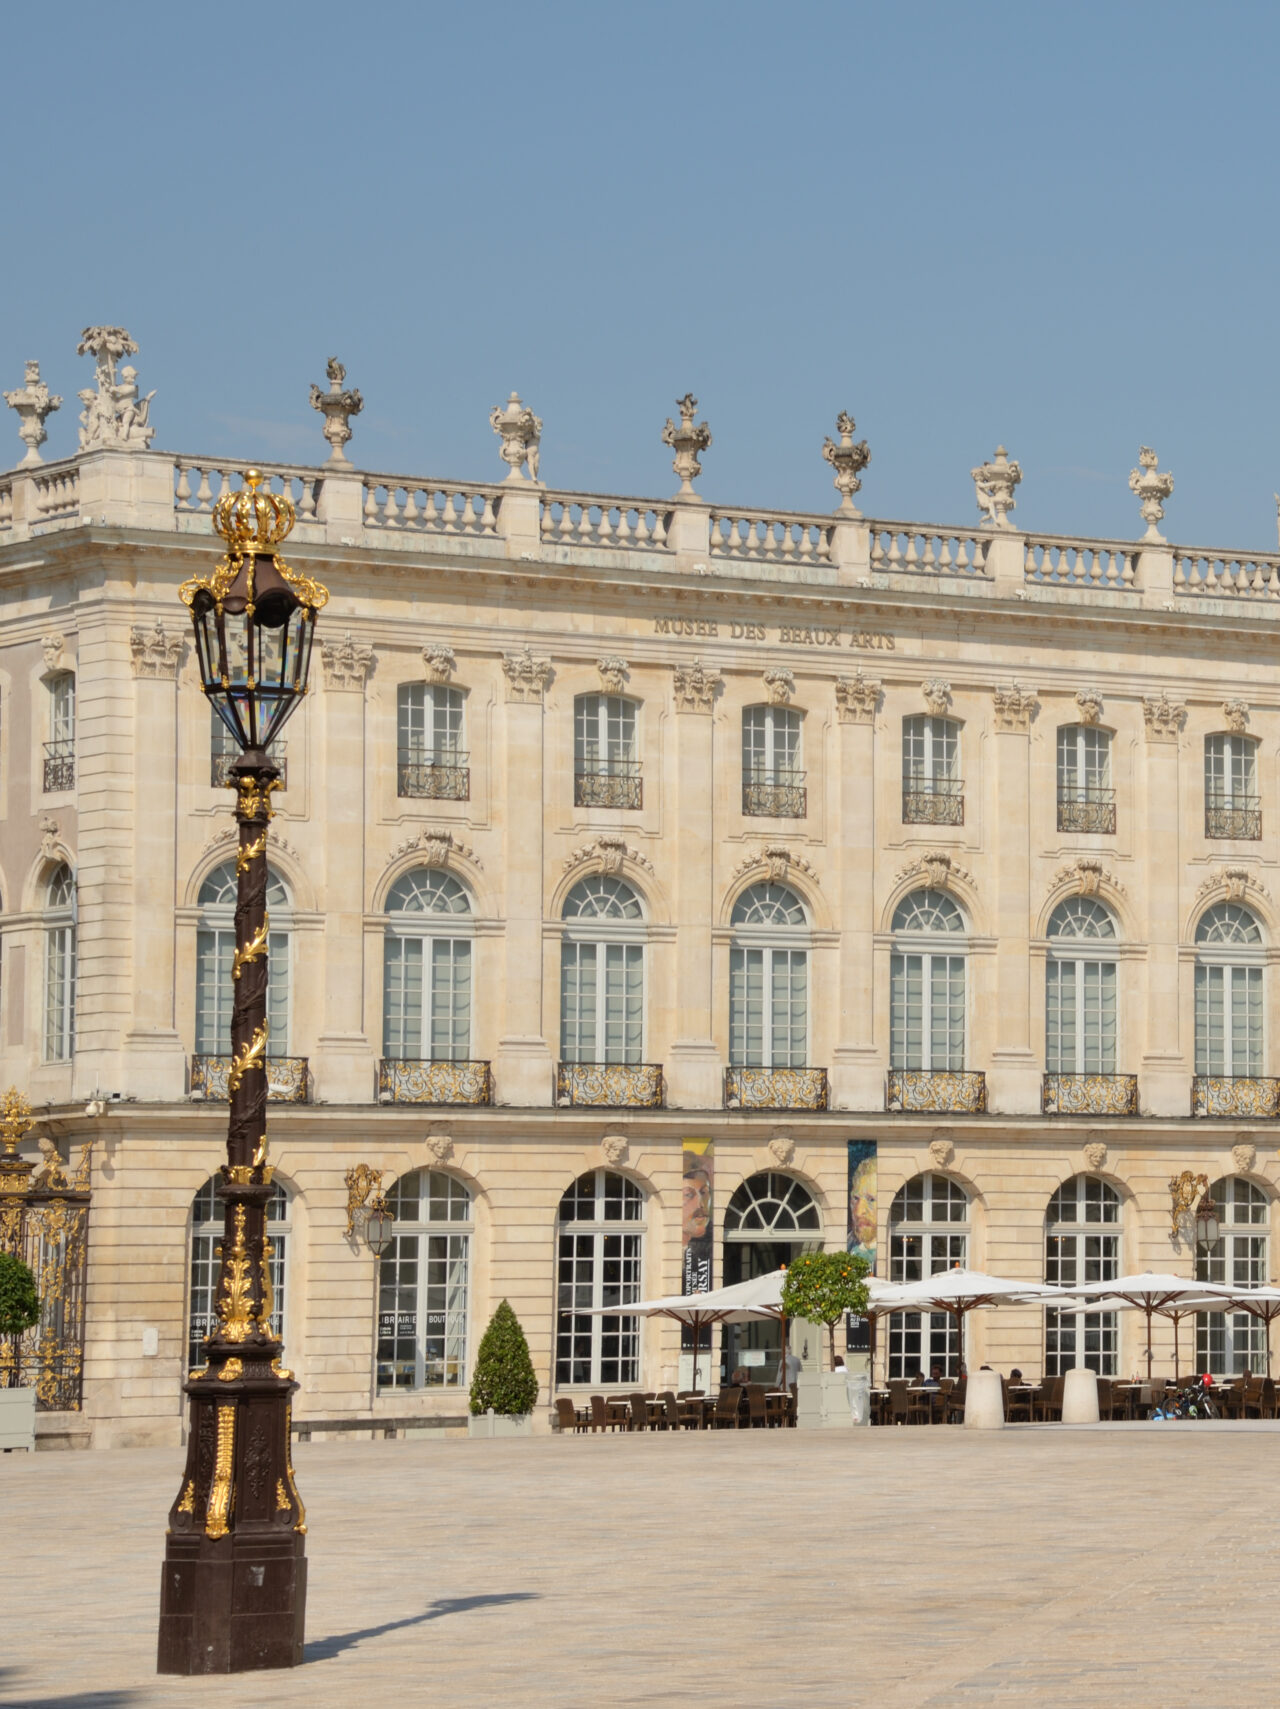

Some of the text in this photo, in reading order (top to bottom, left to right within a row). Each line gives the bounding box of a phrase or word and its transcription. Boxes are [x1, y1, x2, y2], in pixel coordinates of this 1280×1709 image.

[730, 621, 766, 641] DES
[778, 625, 842, 647] BEAUX
[849, 630, 896, 650] ARTS
